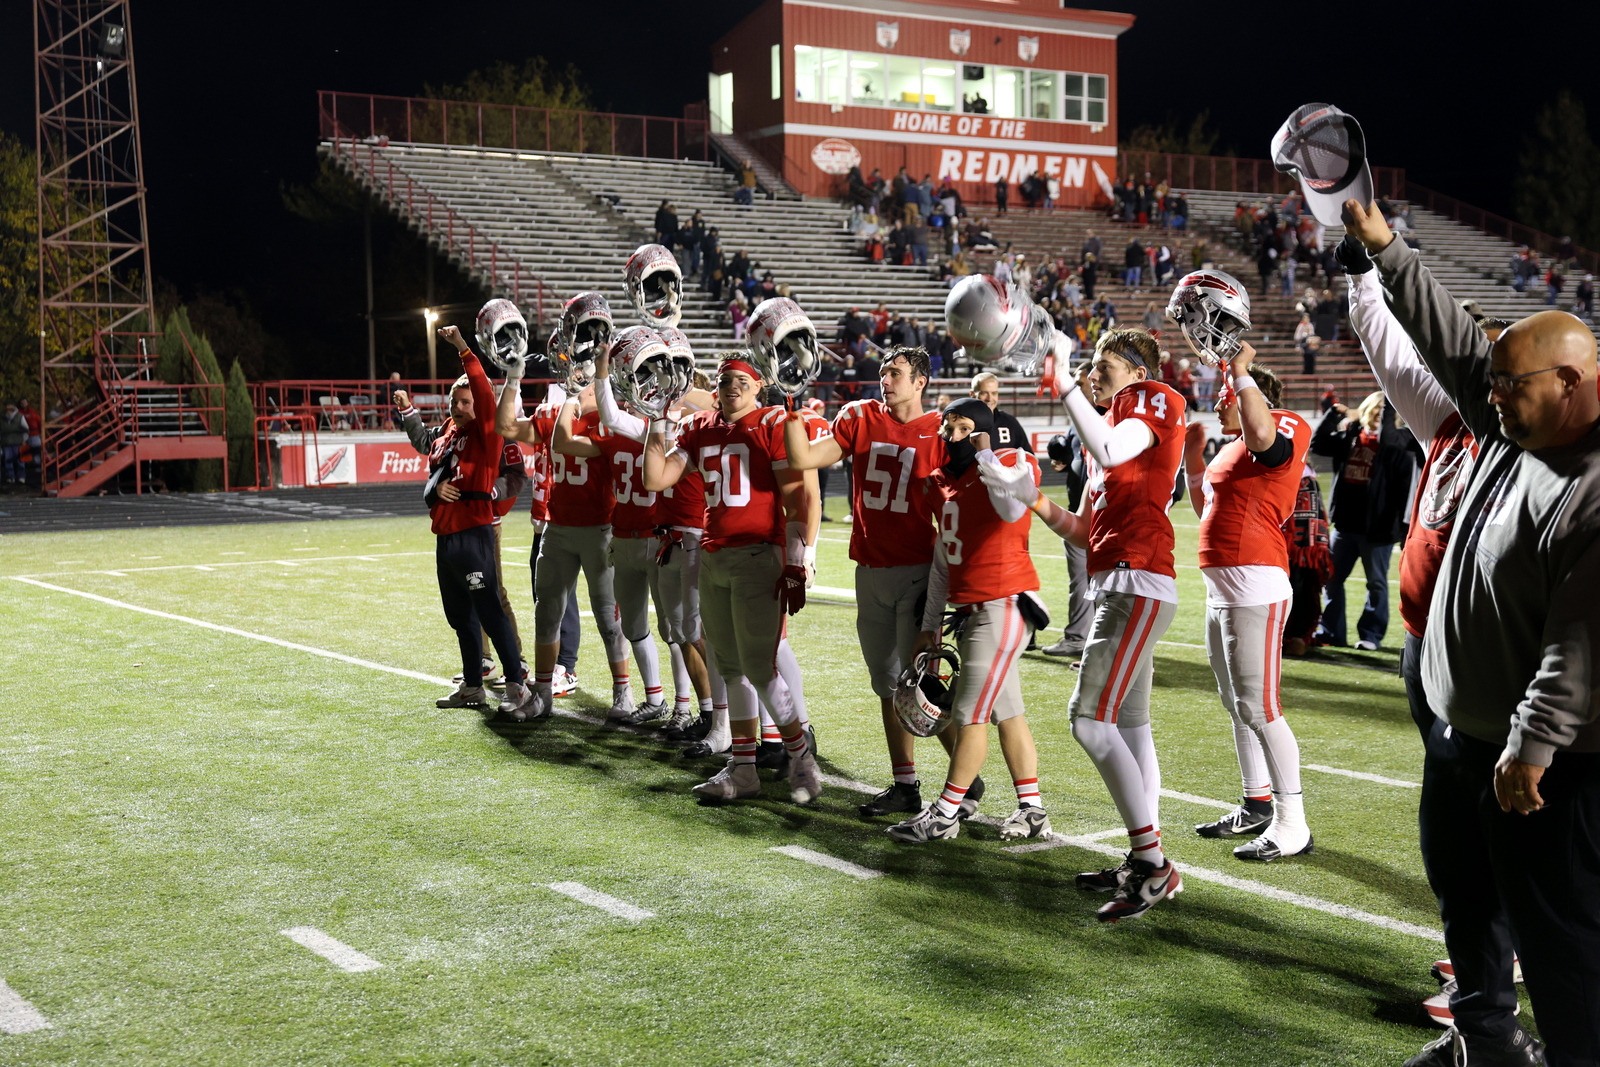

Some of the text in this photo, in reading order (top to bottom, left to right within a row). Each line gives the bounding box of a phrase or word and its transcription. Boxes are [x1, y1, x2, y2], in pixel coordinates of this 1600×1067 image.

[893, 112, 1027, 138] HOME OF THE
[938, 149, 1088, 188] REDMEN
[1134, 390, 1168, 420] 14
[998, 427, 1011, 443] B
[379, 451, 422, 475] First
[698, 443, 751, 508] 50
[863, 441, 917, 514] 51
[941, 501, 963, 565] 8
